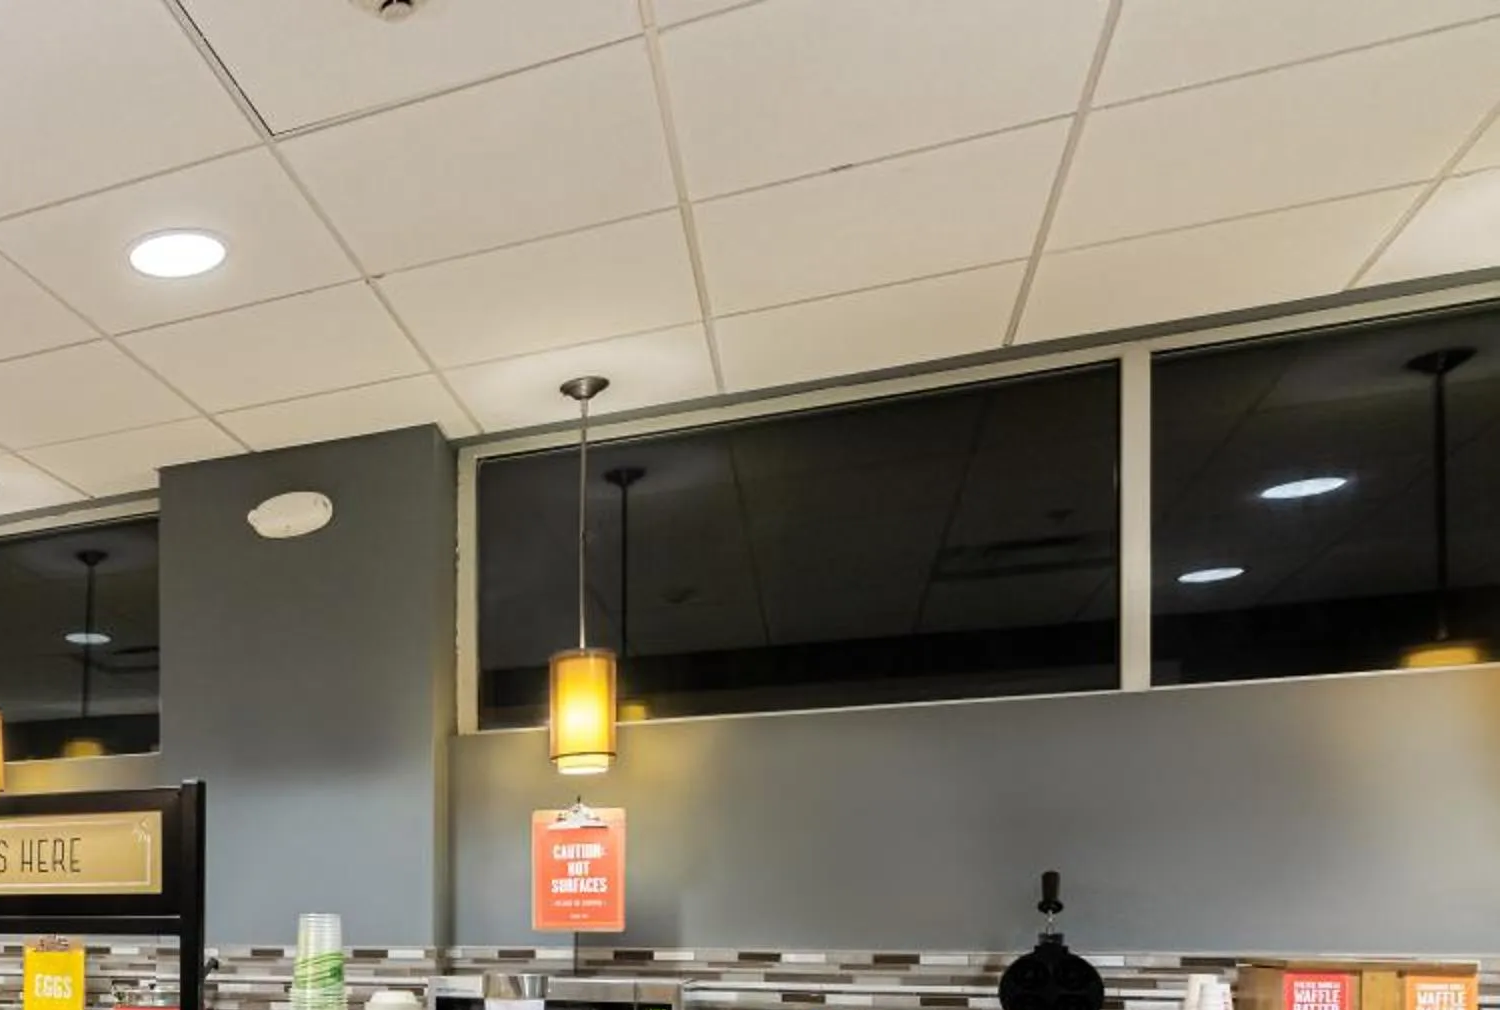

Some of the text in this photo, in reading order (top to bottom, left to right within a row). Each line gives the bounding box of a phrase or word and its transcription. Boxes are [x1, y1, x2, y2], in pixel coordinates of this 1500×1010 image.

[20, 837, 82, 873] HERE
[567, 861, 590, 877] HOT
[551, 877, 608, 893] SURFACES
[35, 974, 73, 998] EGGS
[1294, 989, 1341, 1003] WAFFLE
[1416, 990, 1466, 1006] WAFFLE
